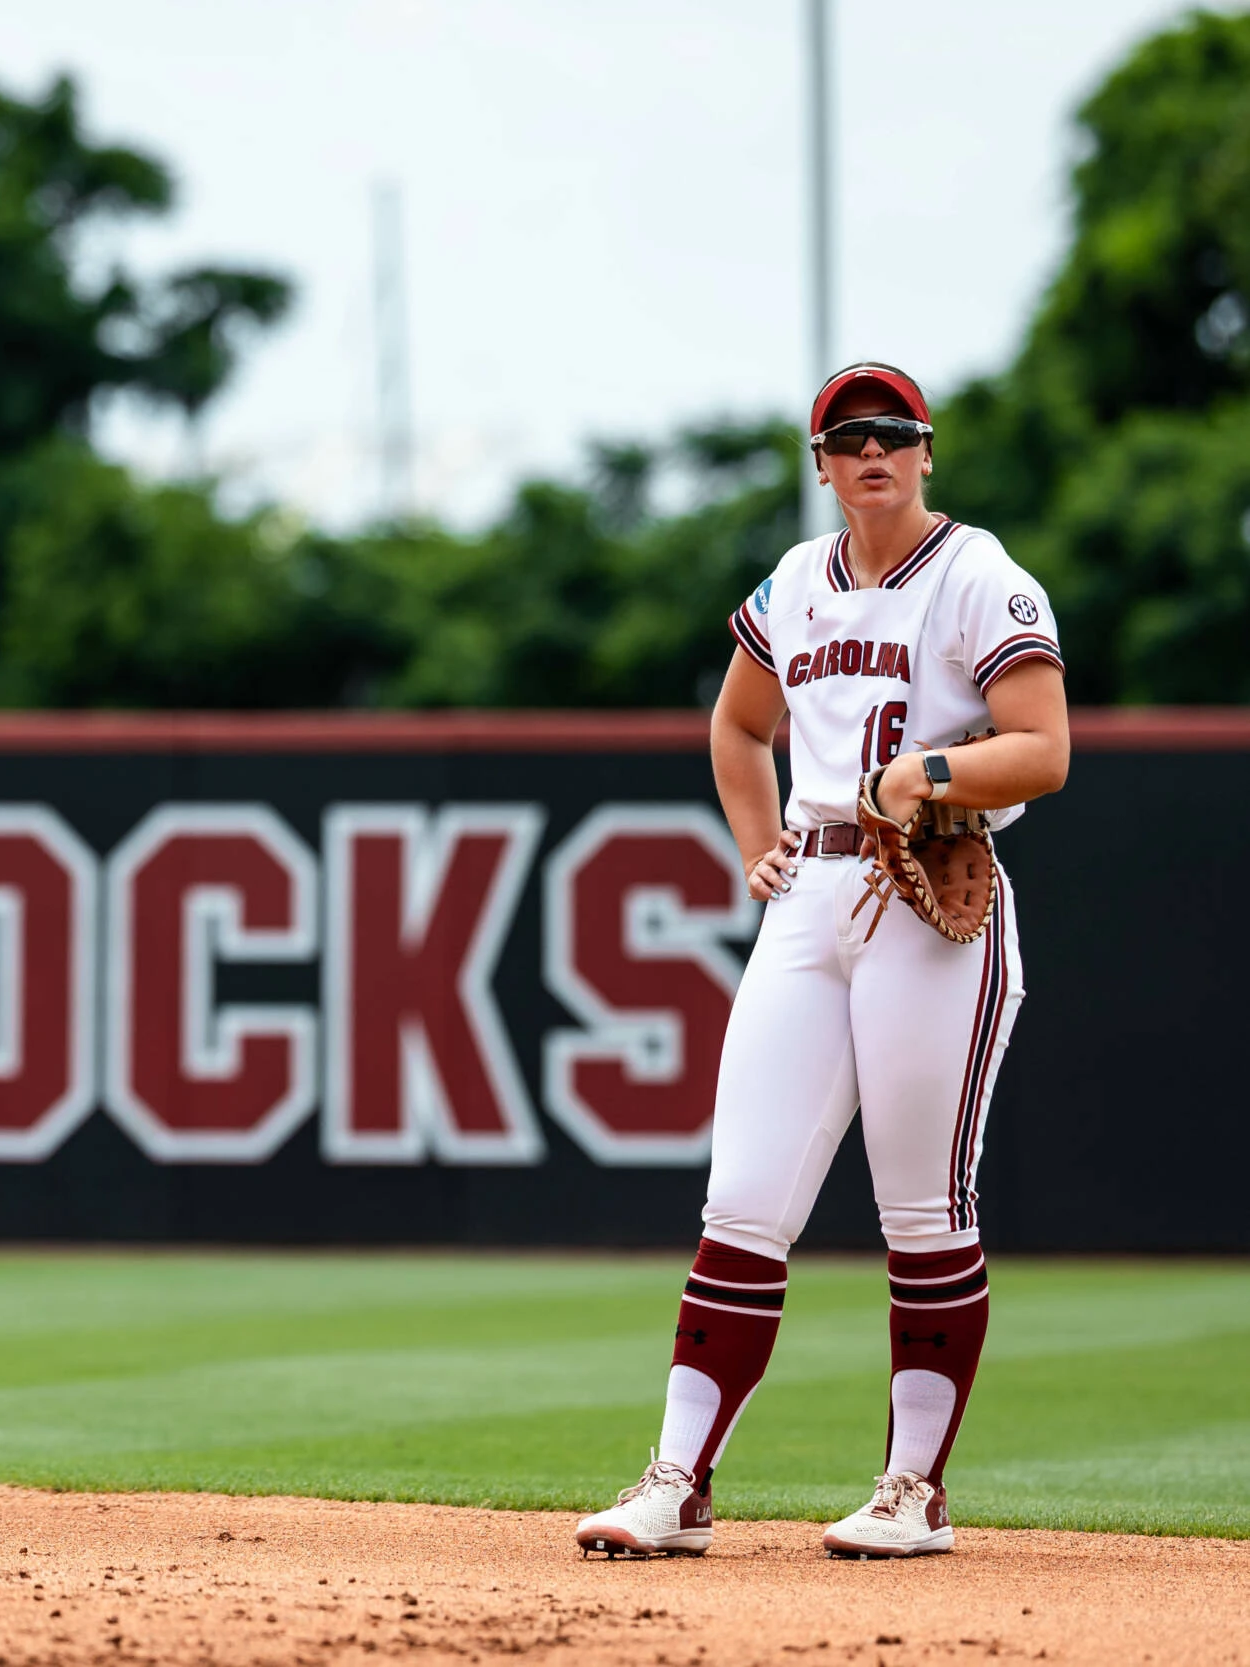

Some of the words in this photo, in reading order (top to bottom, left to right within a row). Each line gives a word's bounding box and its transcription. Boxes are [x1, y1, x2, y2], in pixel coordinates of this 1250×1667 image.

[1009, 595, 1038, 624] SEC
[786, 639, 911, 688] CAROLINA
[861, 701, 908, 773] 16
